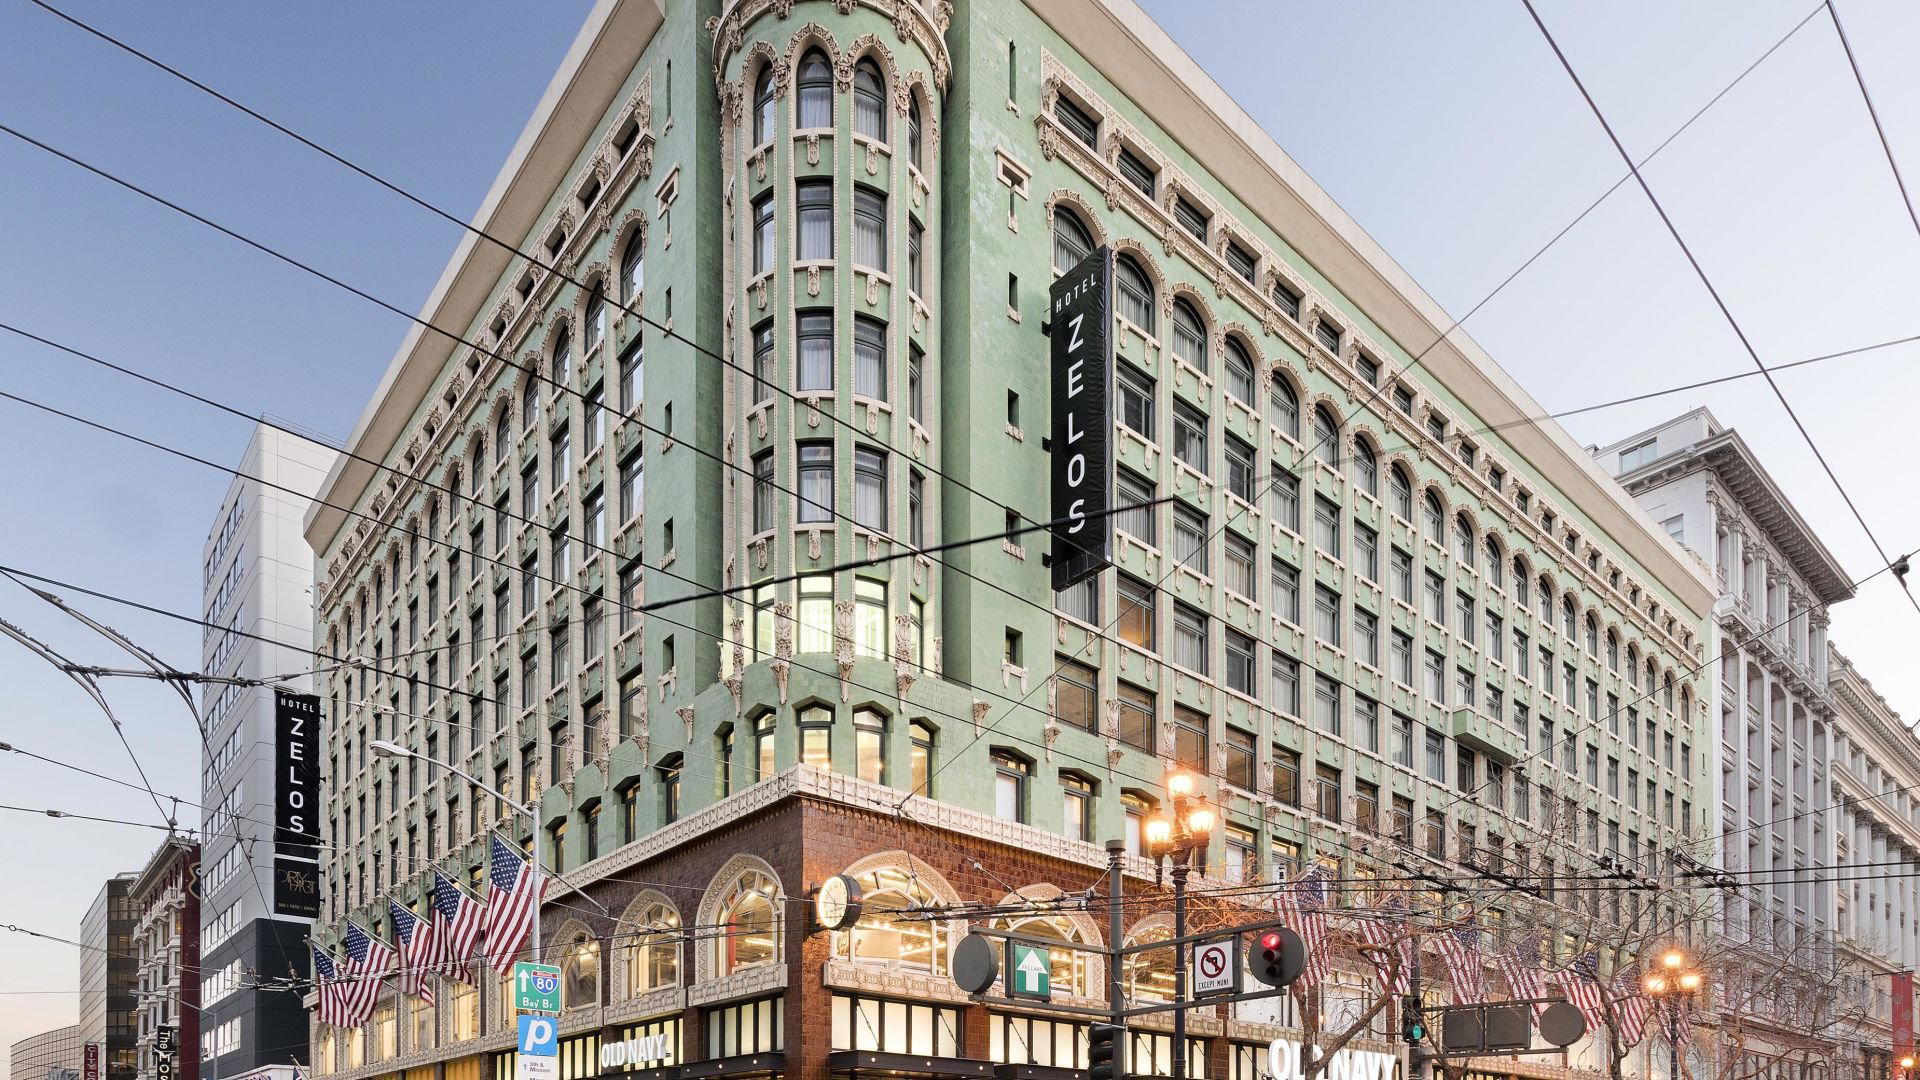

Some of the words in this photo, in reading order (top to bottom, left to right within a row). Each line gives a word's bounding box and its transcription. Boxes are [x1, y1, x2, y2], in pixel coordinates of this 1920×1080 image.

[1056, 273, 1097, 314] HOTEL
[1067, 313, 1085, 534] ZELOS
[280, 698, 315, 713] HOTEL
[289, 717, 304, 834] ZELOS
[536, 977, 554, 991] 80
[1198, 980, 1215, 990] EXCEPT
[1216, 978, 1229, 987] MUNI
[522, 996, 540, 1008] Bay
[542, 999, 553, 1009] Br
[160, 1030, 170, 1049] The
[601, 1041, 626, 1068] OLD
[628, 1033, 667, 1064] NAVY
[1331, 1048, 1397, 1080] NAVY
